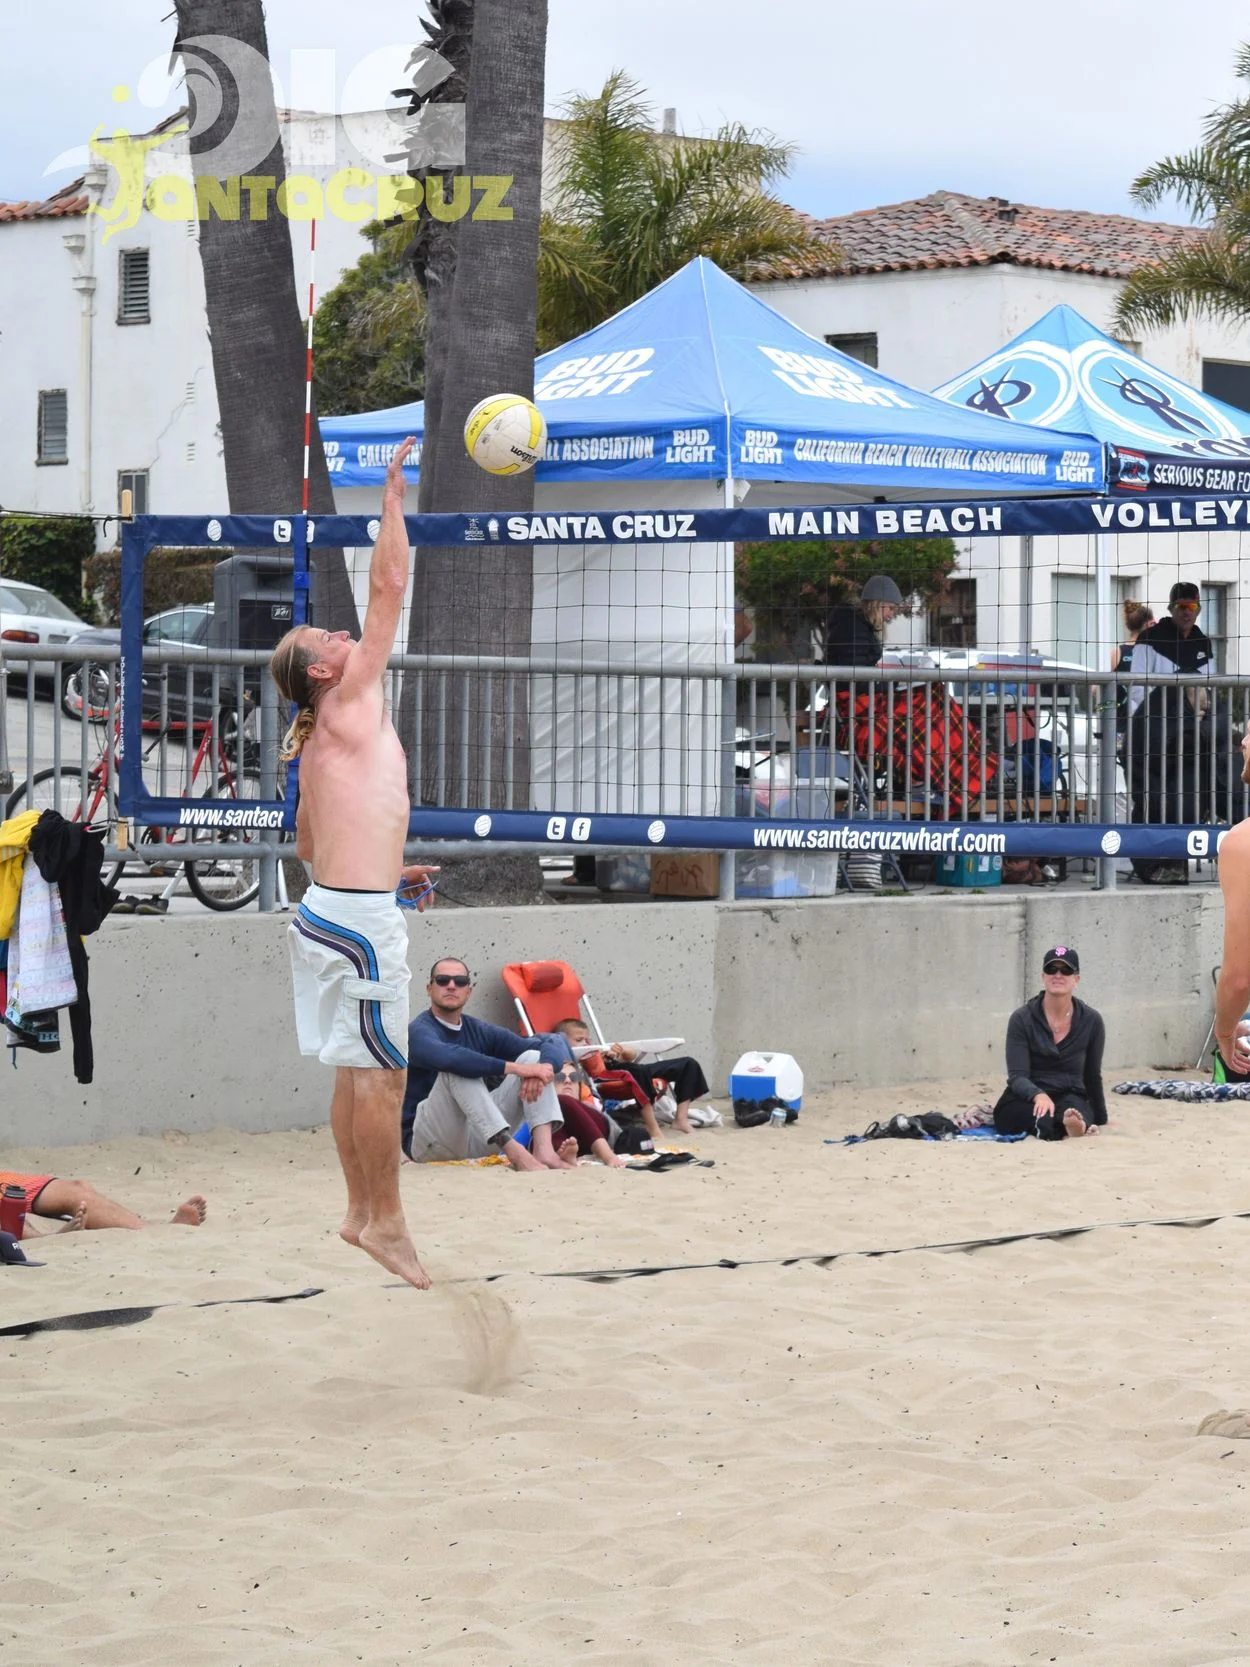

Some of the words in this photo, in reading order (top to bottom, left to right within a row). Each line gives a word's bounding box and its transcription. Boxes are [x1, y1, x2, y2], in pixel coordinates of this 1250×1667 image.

[540, 347, 655, 381] BUD
[758, 346, 863, 385] BUD
[772, 369, 918, 409] LIGHT
[563, 436, 654, 462] ASSOCIATION
[672, 430, 710, 447] BUD
[744, 430, 778, 448] BUD
[665, 446, 715, 464] LIGHT
[740, 447, 783, 464] LIGHT
[794, 438, 862, 464] CALIFORNIA
[864, 443, 901, 466] BEACH
[906, 446, 971, 471] VOLLEYBALL
[972, 450, 1047, 476] ASSOCIATION
[1060, 450, 1090, 467] BUD
[1056, 466, 1095, 483] LIGHT
[1153, 463, 1204, 487] SERIOUS
[1205, 468, 1236, 490] GEAR
[507, 516, 605, 541] SANTA
[612, 514, 697, 540] CRUZ
[769, 511, 860, 536] MAIN
[875, 507, 1002, 534] BEACH
[753, 825, 1006, 853] www.santacruzwharf.com
